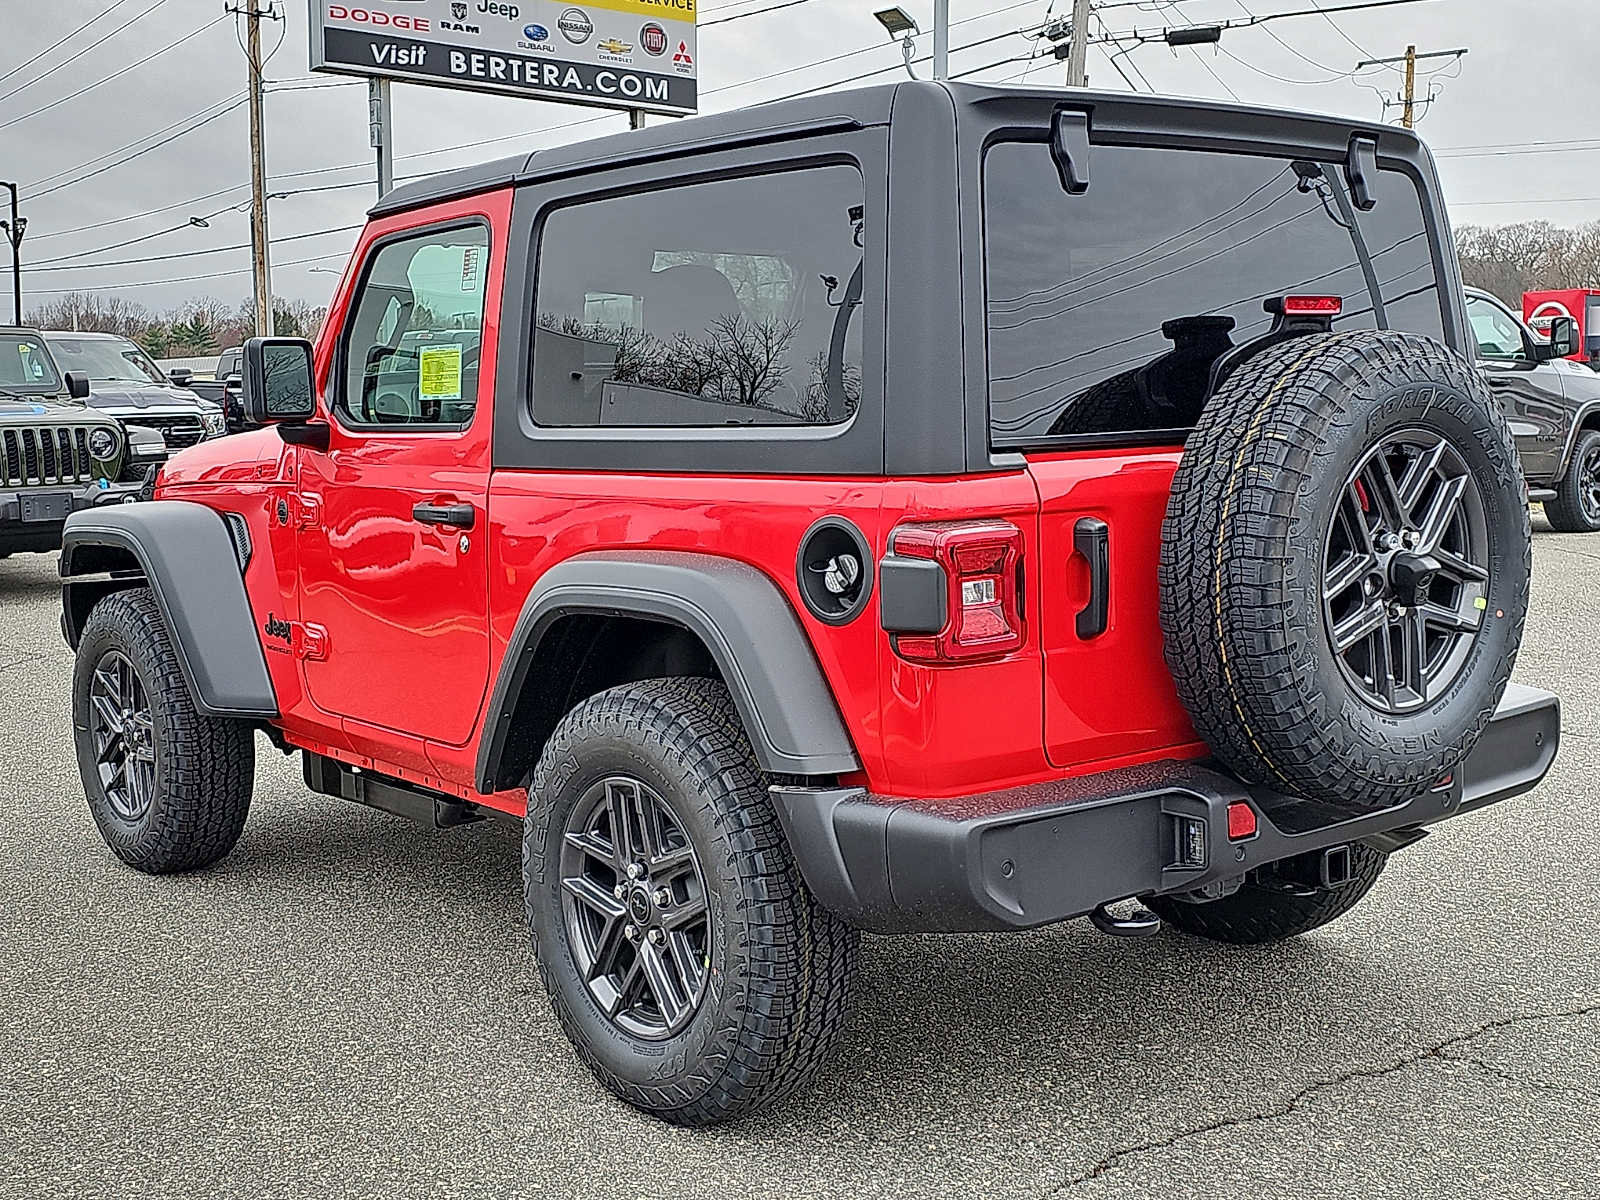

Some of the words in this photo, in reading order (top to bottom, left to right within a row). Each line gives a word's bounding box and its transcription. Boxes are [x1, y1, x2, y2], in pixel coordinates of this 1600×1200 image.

[477, 0, 519, 20] Jeep
[640, 0, 693, 10] VICE
[329, 5, 430, 32] DODGE
[440, 21, 480, 34] RAM
[560, 22, 591, 33] NISSAN
[517, 41, 555, 53] SUBARU
[646, 31, 663, 48] FIAT
[599, 54, 633, 64] CHEVROLET
[370, 43, 427, 66] Visit
[450, 50, 670, 101] BERTERA.COM
[265, 611, 292, 645] Jeep
[1341, 699, 1441, 756] NEXEN
